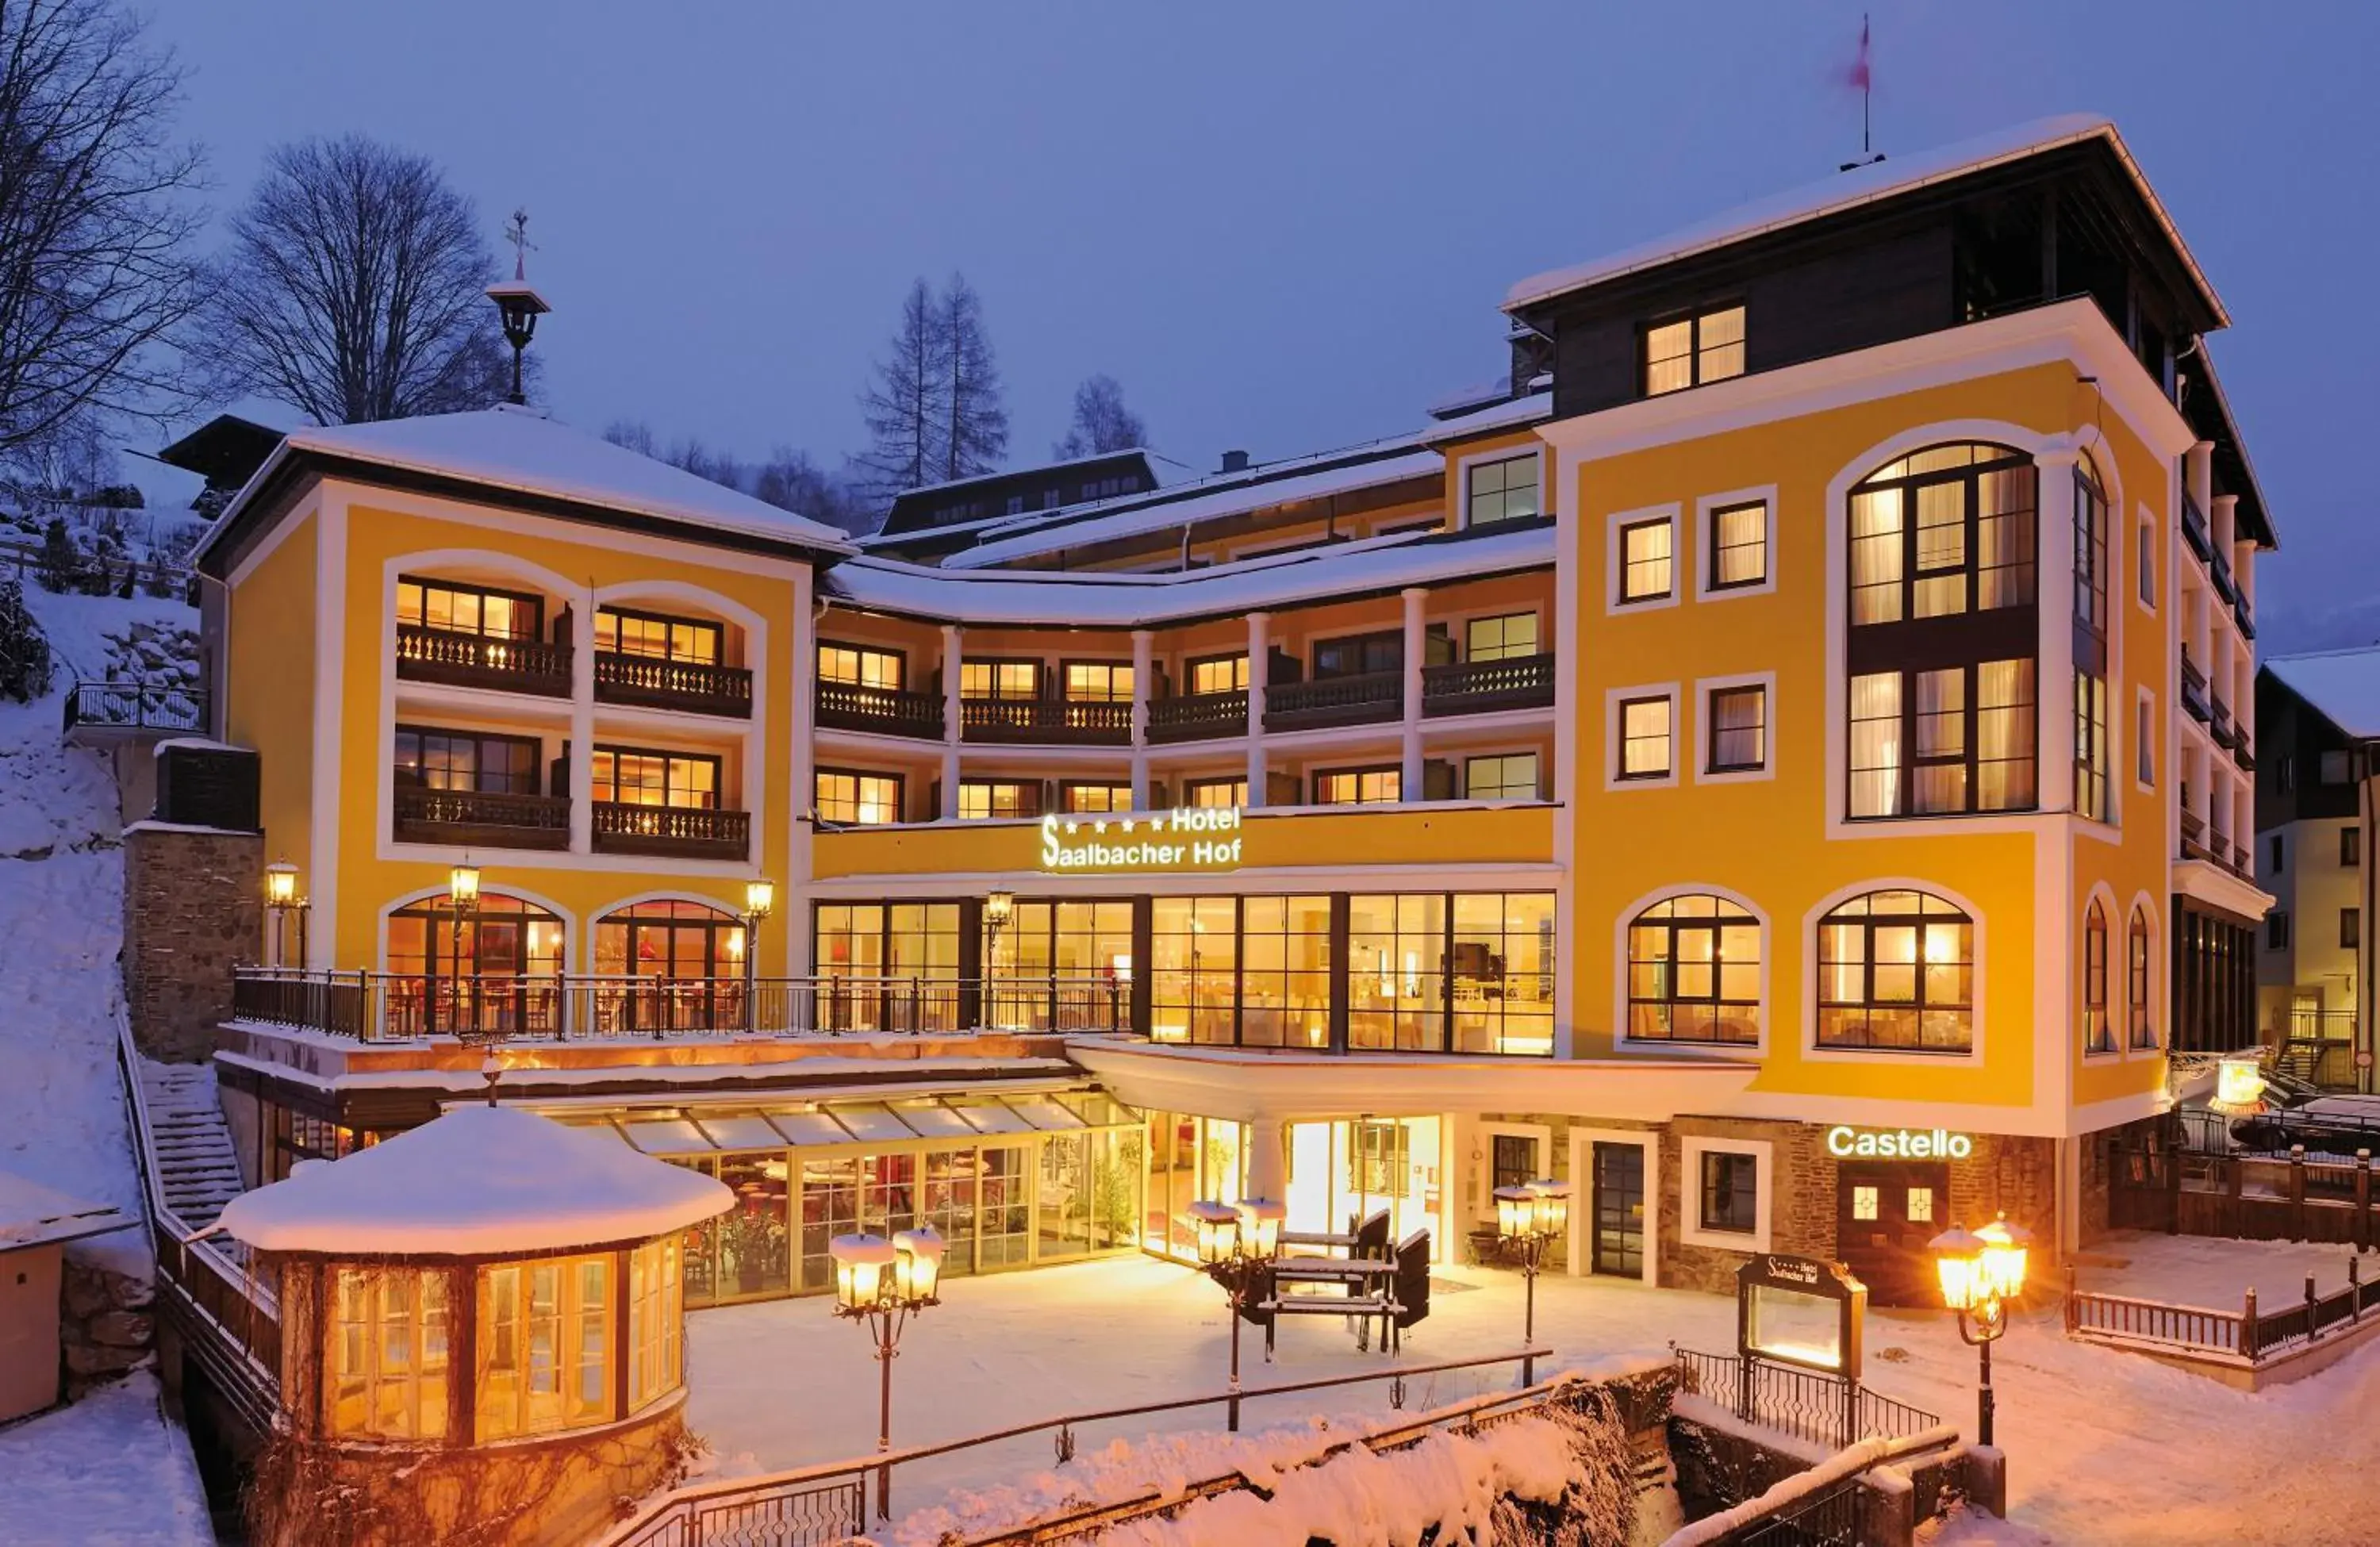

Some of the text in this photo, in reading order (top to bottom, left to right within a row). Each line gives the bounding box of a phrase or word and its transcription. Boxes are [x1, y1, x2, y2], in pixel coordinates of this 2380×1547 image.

[1172, 806, 1240, 831] Hotel
[1042, 814, 1242, 866] Saalbacher Hof
[1828, 1127, 1971, 1157] Castello
